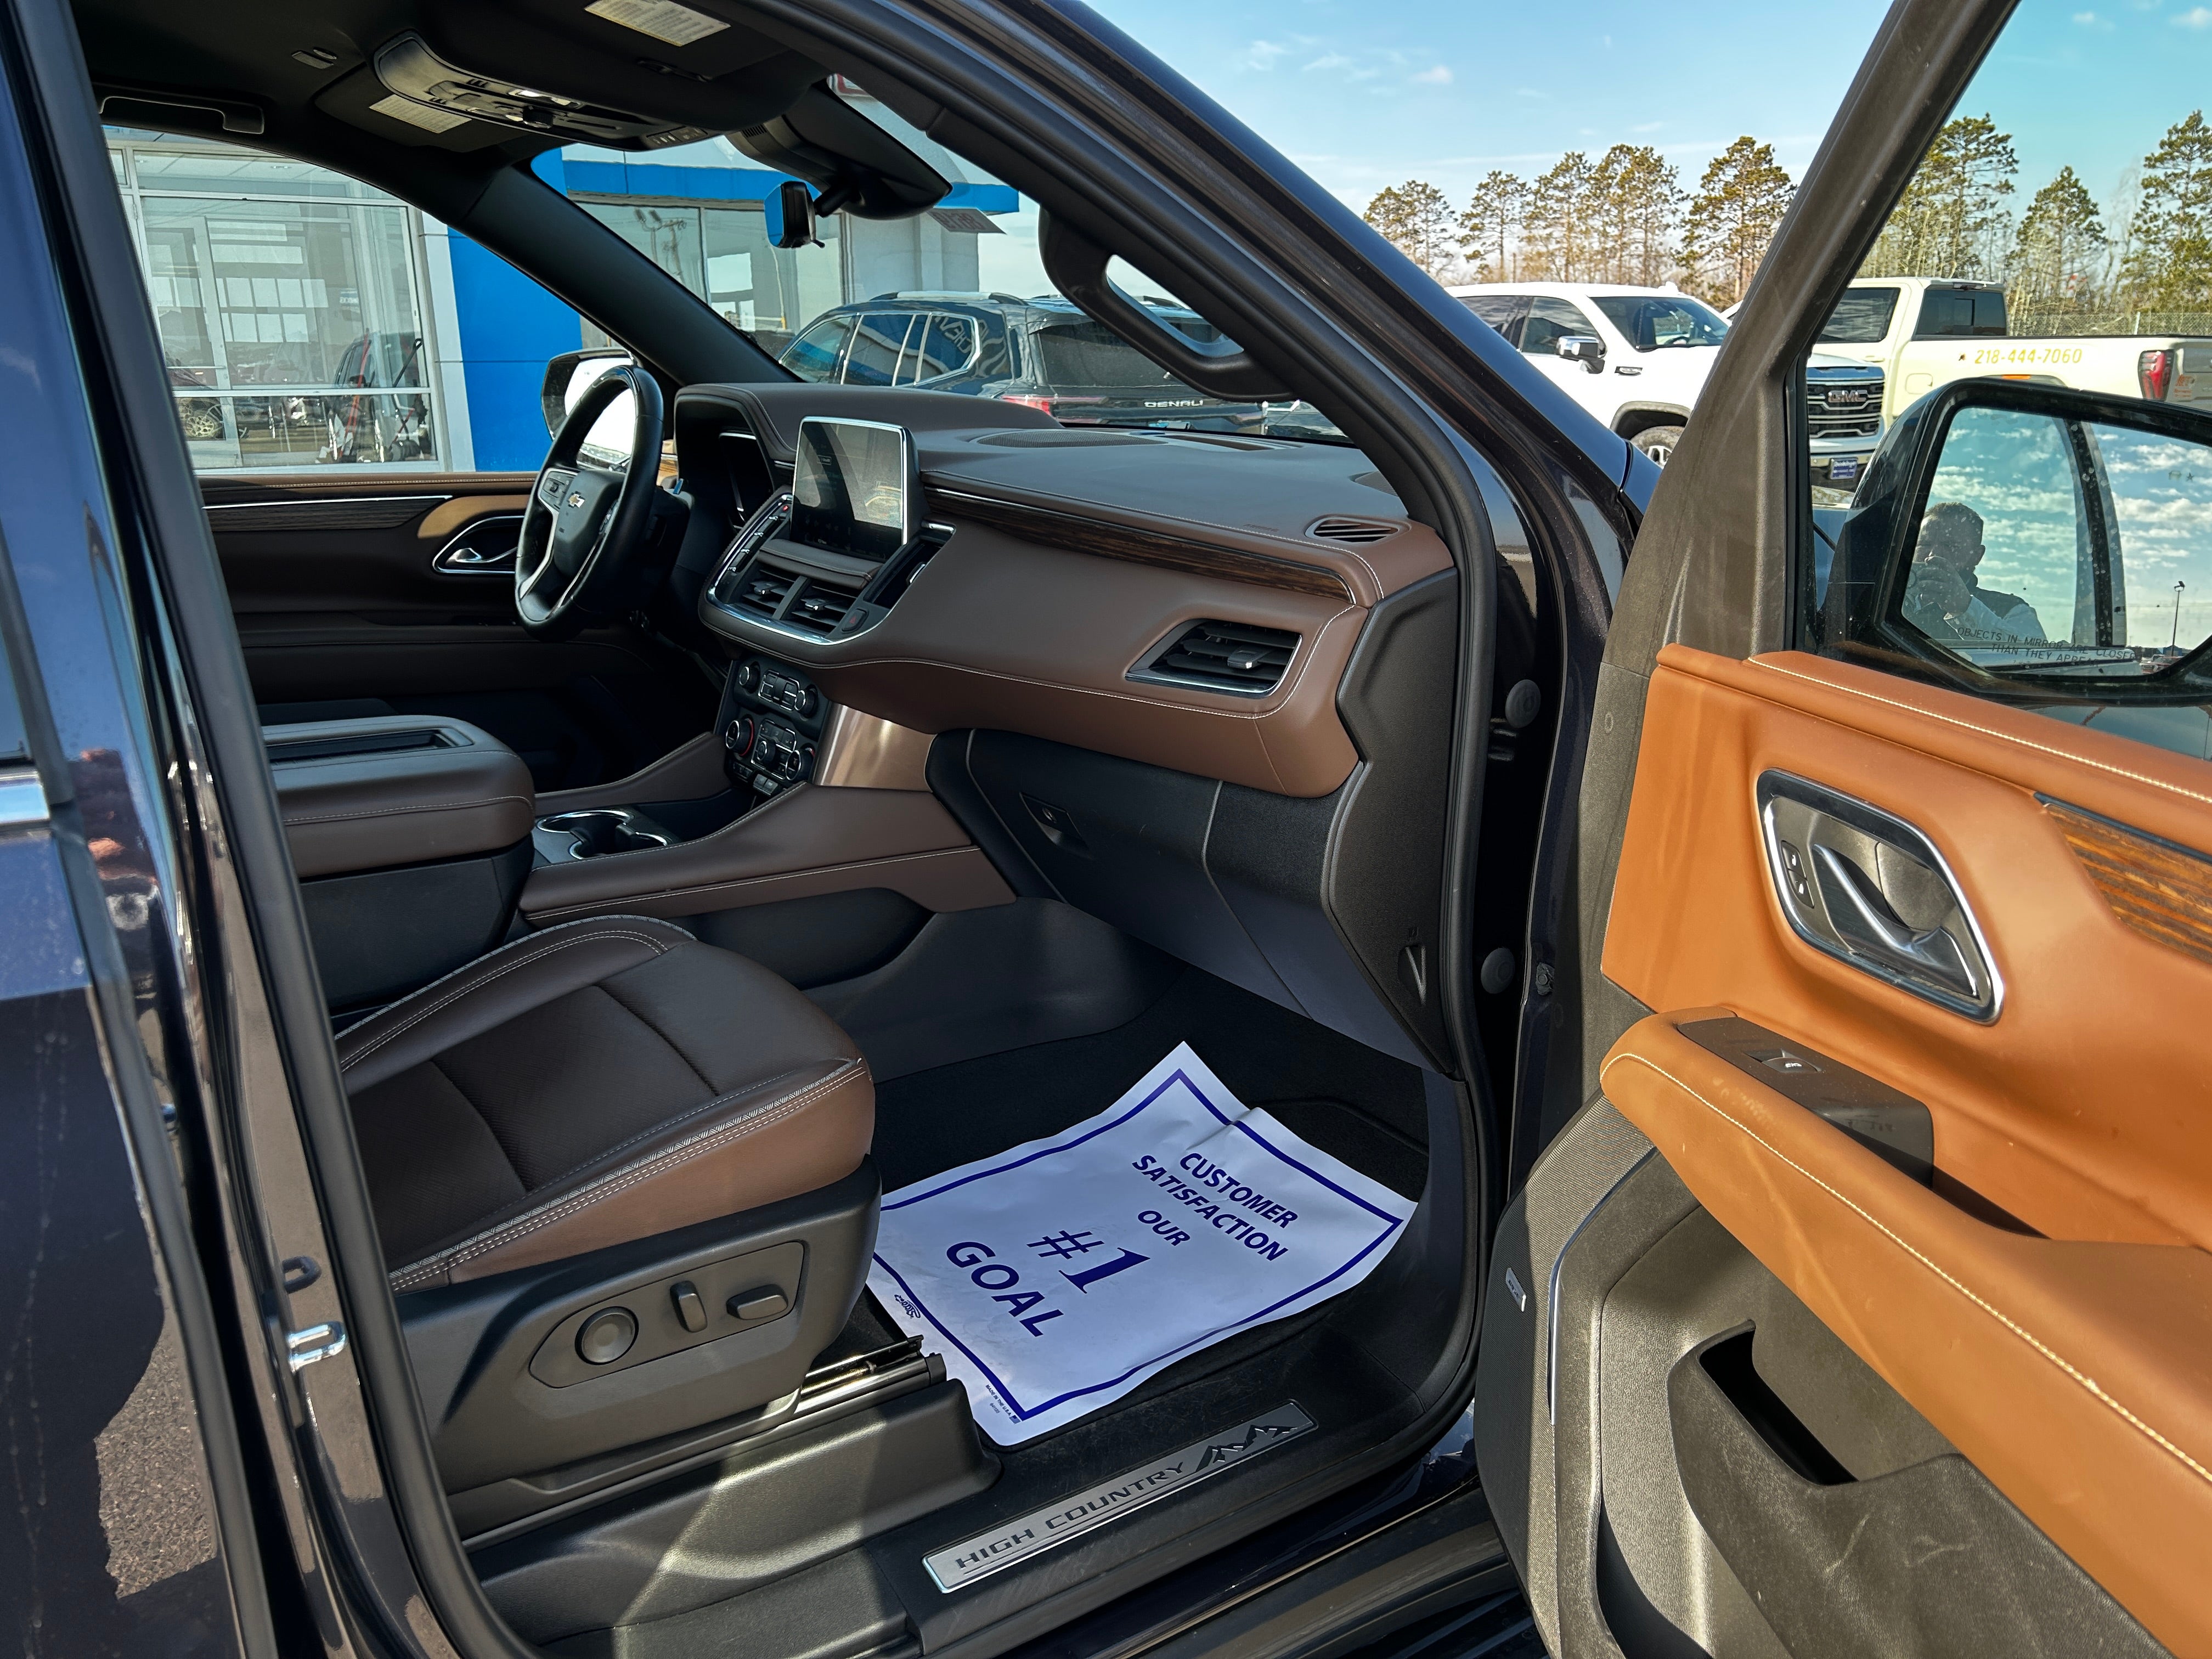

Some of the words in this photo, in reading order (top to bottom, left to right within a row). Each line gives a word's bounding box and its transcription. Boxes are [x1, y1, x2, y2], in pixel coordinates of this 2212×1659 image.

[1974, 348, 2083, 364] 218-444-7060
[1144, 399, 1204, 408] DENALI
[1828, 390, 1868, 403] GMC
[1957, 628, 2002, 641] OBJECTS
[2007, 635, 2018, 644] IN
[2024, 637, 2063, 651] MIRROR
[2096, 649, 2136, 659] CLOSER
[1991, 643, 2018, 655] THAN
[2025, 648, 2053, 660] THEY
[1180, 1153, 1298, 1229] CUSTOMER
[1132, 1155, 1289, 1261] SATISFACTION
[1137, 1210, 1190, 1246] OUR
[1026, 1230, 1150, 1294] #1
[946, 1242, 1064, 1337] GOAL
[985, 1384, 996, 1396] MADE
[955, 1528, 1035, 1570] HIGH
[1045, 1462, 1184, 1530] COUNTRY
